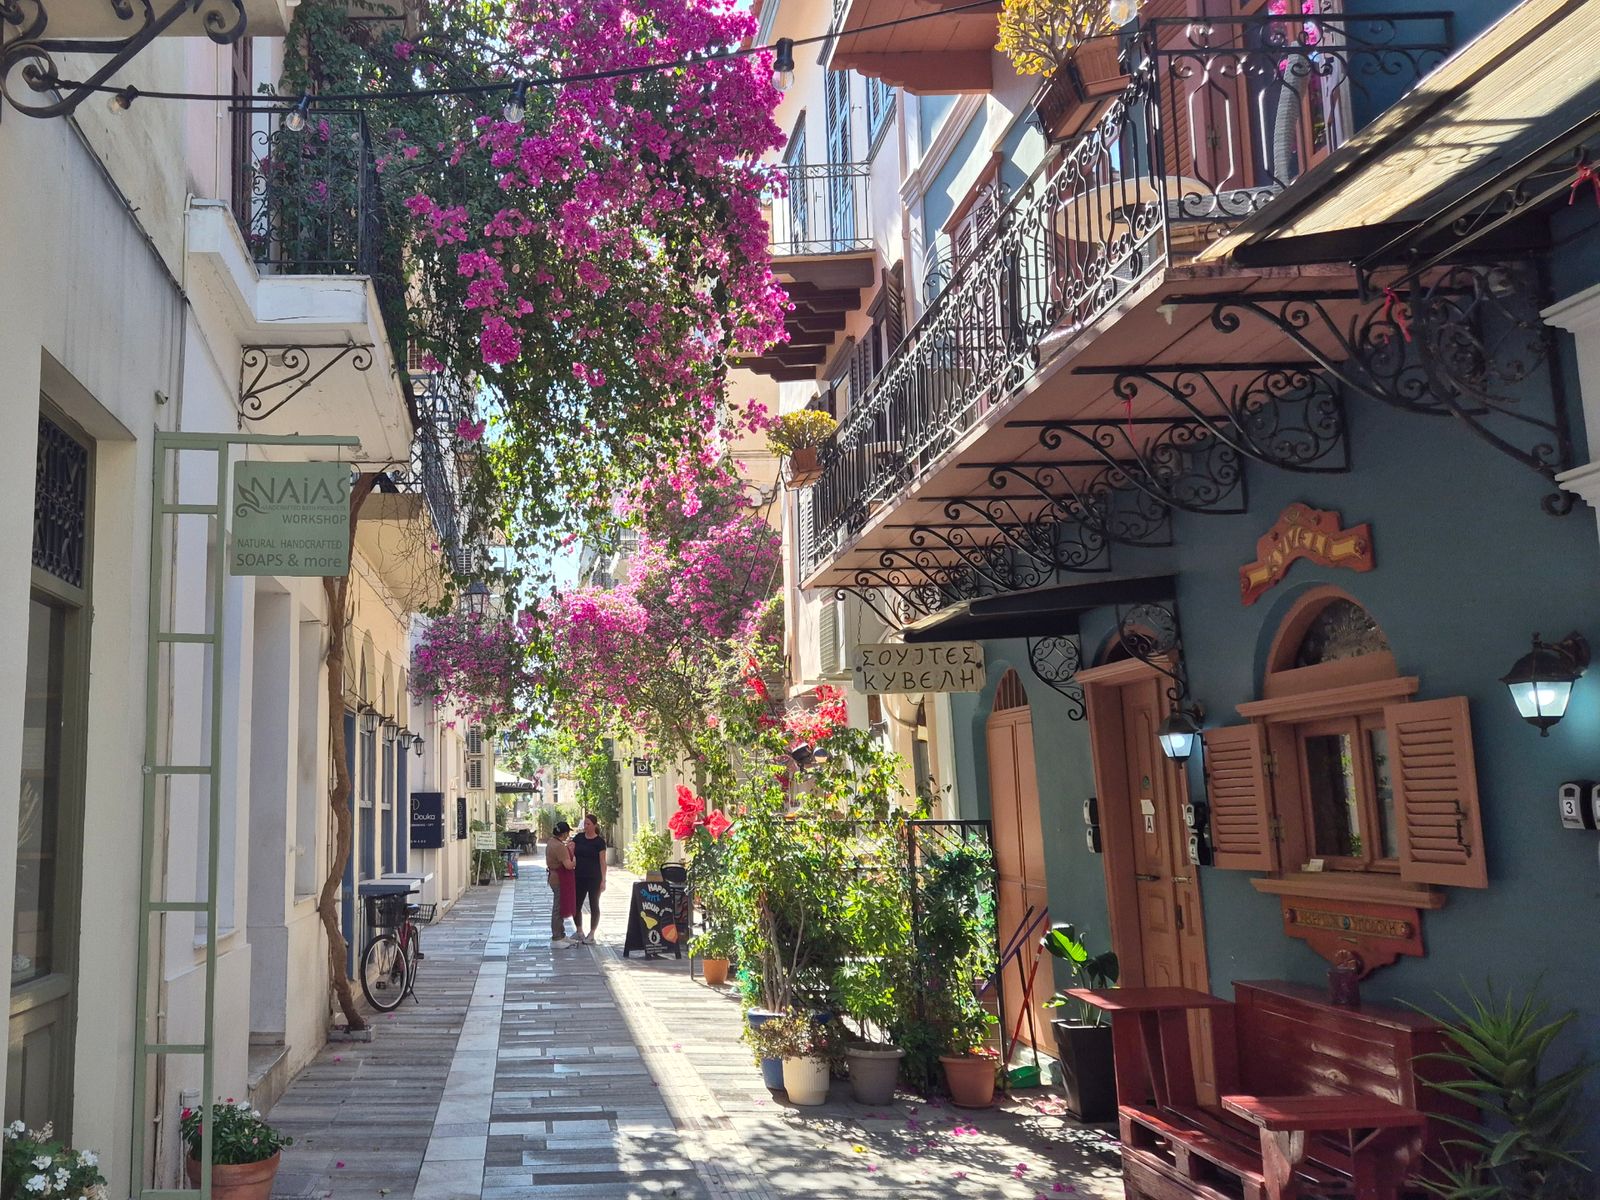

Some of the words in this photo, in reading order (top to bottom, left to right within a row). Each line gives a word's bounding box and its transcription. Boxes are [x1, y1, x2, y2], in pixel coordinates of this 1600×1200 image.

[282, 514, 347, 524] WORKSHOP
[237, 539, 275, 549] NATURAL
[280, 539, 343, 549] HANDCRAFTED
[236, 553, 283, 567] SOAPS
[287, 554, 299, 567] &
[304, 557, 342, 567] more
[863, 669, 975, 691] ΚΥΒΕΛΗ
[1565, 801, 1574, 814] 3
[413, 812, 436, 821] Douka
[1146, 817, 1152, 832] A
[648, 883, 670, 898] HAPPY
[642, 901, 660, 914] HOUR
